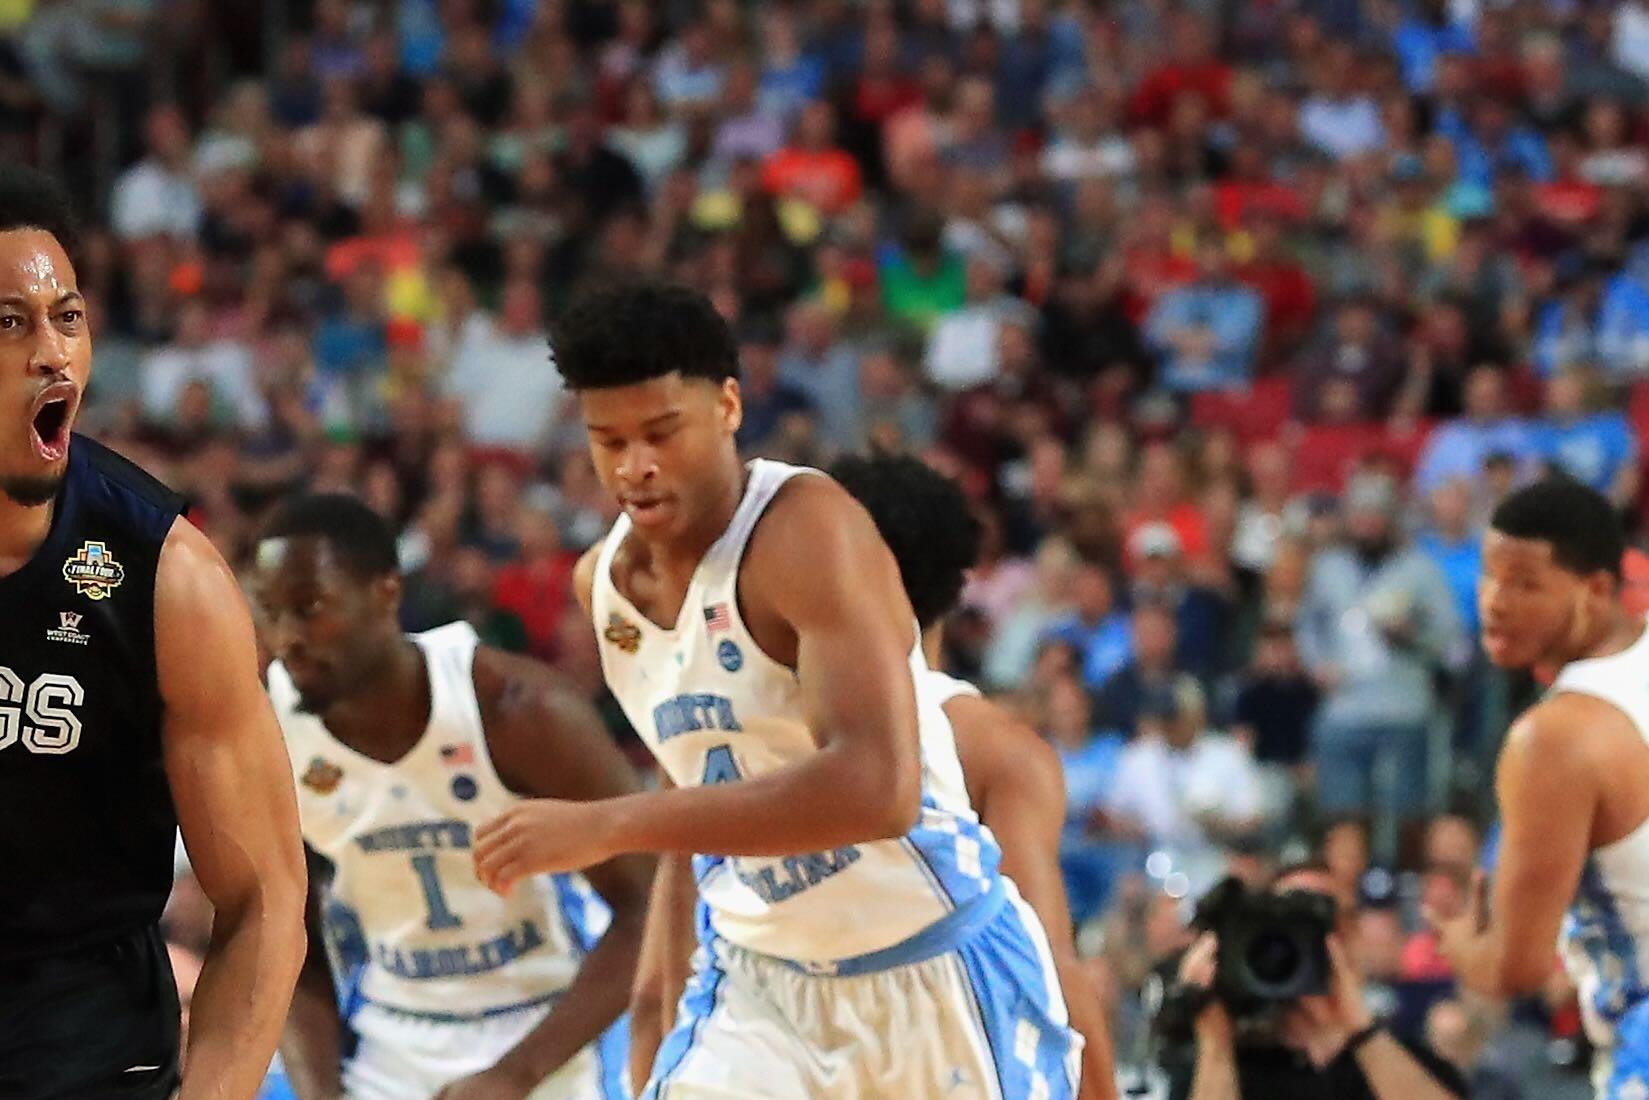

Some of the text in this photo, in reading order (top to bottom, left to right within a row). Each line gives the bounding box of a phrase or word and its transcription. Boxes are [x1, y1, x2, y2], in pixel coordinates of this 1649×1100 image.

[654, 693, 743, 743] NORTH
[354, 818, 471, 854] NORTH
[410, 855, 462, 930] 1
[373, 920, 545, 979] CAROLINA
